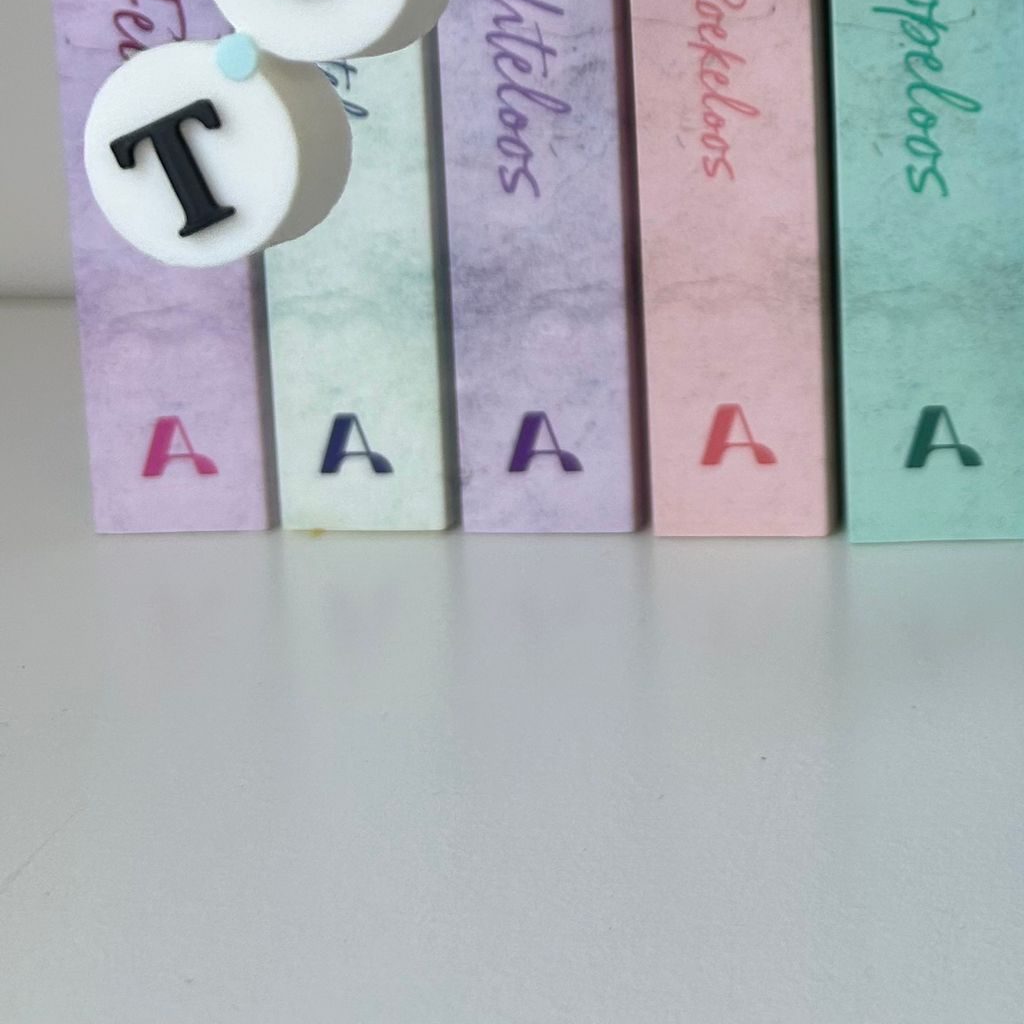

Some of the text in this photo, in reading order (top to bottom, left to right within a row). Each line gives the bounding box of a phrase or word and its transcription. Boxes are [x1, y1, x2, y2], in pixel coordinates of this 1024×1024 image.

[141, 414, 220, 478] A
[319, 411, 395, 475] A
[507, 410, 583, 473] A
[699, 402, 778, 467] A
[905, 403, 983, 469] A
